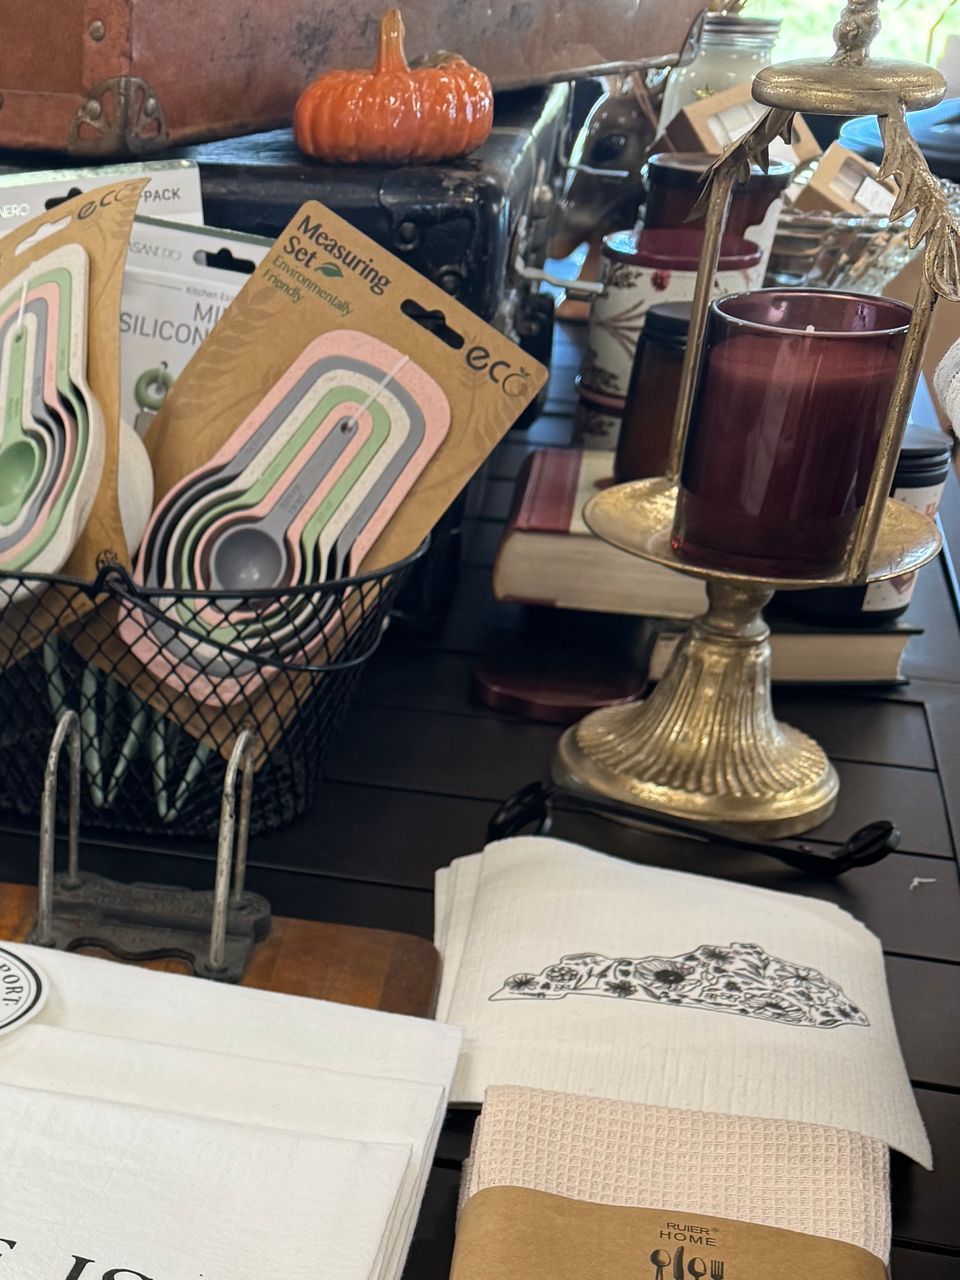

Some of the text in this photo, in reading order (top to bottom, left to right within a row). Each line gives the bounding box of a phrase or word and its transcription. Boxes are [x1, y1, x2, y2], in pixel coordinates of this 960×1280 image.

[127, 240, 182, 263] ASANERO
[283, 234, 318, 270] Set
[296, 213, 393, 296] Measuring
[262, 268, 306, 305] Friendly
[271, 254, 356, 318] Environmentally
[465, 344, 530, 398] eco
[659, 1230, 717, 1247] HOME
